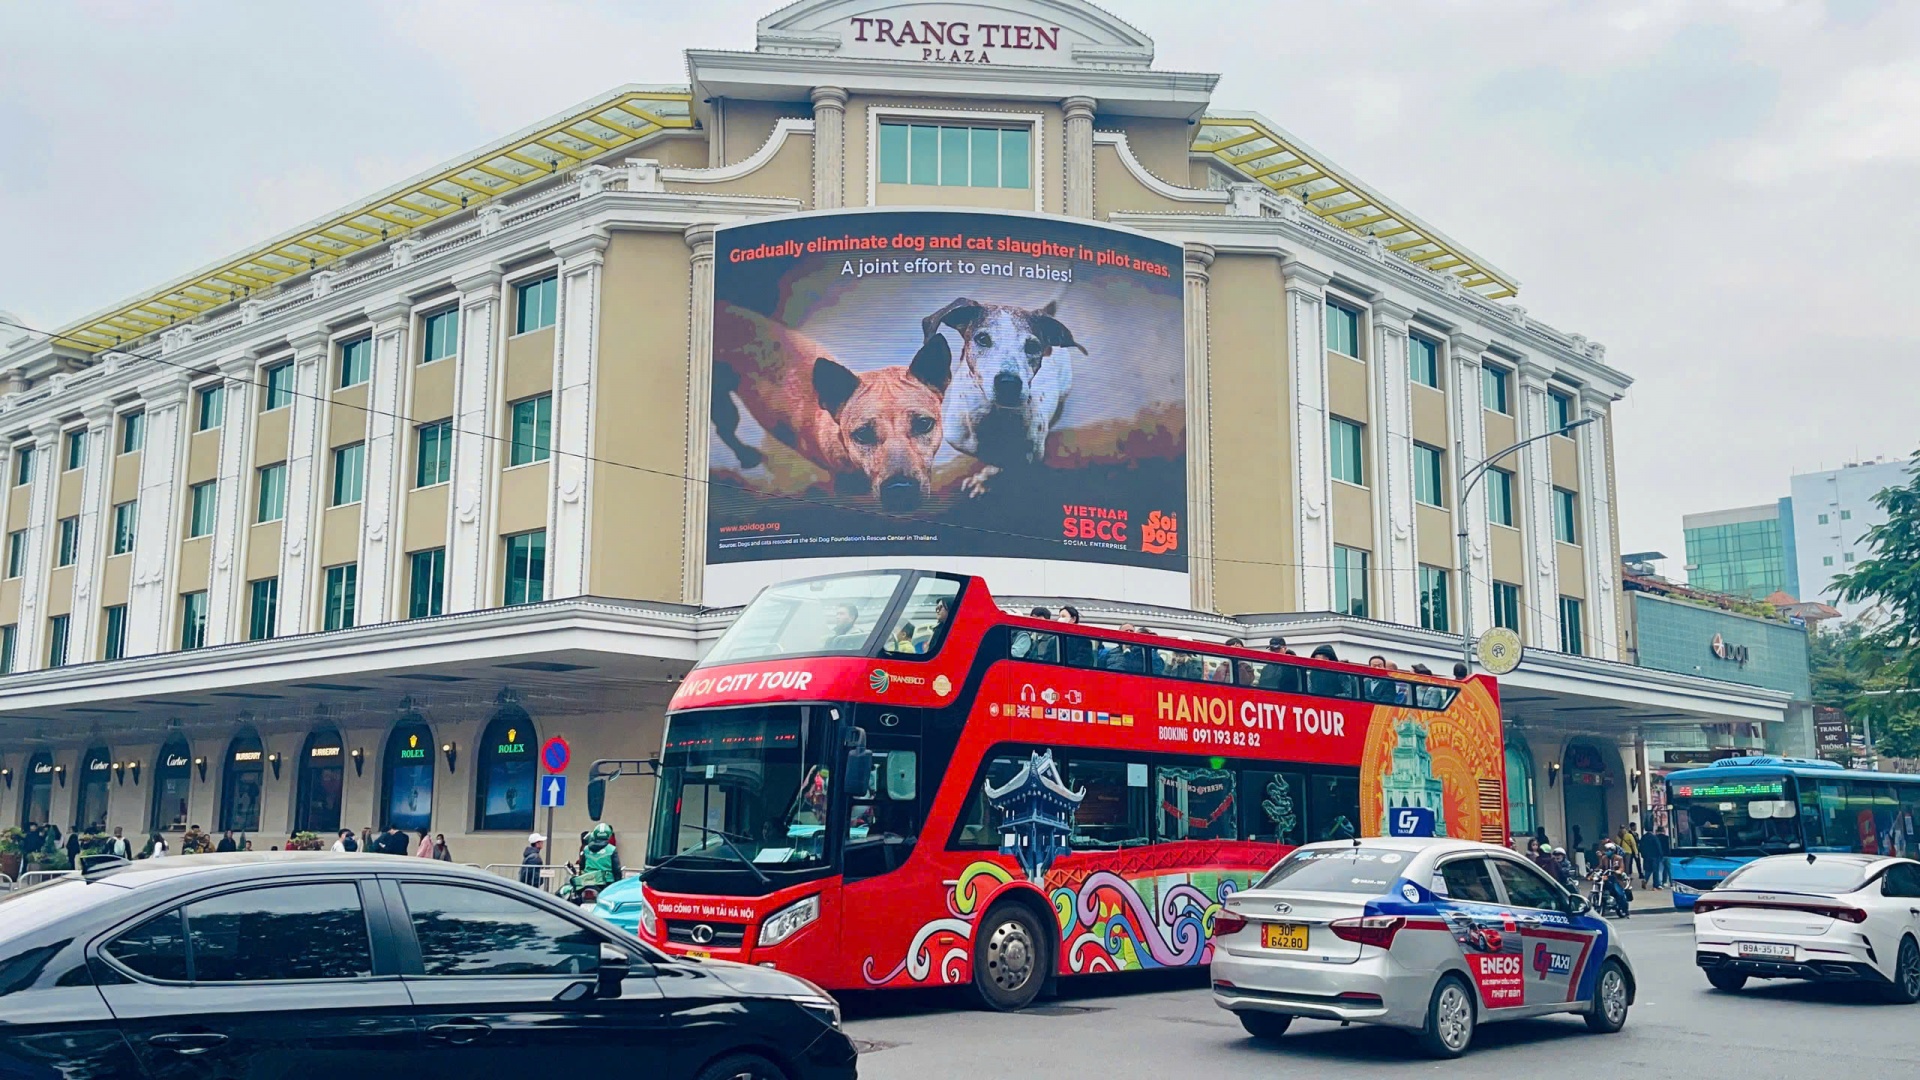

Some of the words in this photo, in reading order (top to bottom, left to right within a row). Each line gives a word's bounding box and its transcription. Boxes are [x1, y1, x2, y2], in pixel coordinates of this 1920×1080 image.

[850, 17, 970, 47] TRANG
[977, 23, 1060, 50] TIEN
[922, 48, 991, 63] PLAZA
[729, 239, 804, 263] Gradually
[806, 234, 888, 253] eliminate
[891, 233, 925, 251] dog
[928, 233, 962, 249] and
[966, 236, 993, 250] cat
[997, 237, 1076, 258] slaughter
[1079, 244, 1093, 262] in
[1096, 249, 1131, 268] pilot
[1132, 257, 1171, 278] areas.
[841, 260, 854, 275] A
[857, 258, 899, 278] joint
[903, 257, 953, 274] effort
[957, 260, 976, 274] to
[980, 261, 1013, 276] end
[1019, 263, 1073, 283] rabies!
[1063, 504, 1128, 520] VIETNAM
[719, 522, 781, 533] www.soidog.org
[1149, 510, 1177, 532] Soi
[1063, 518, 1127, 542] SBCC
[1089, 541, 1128, 550] ENTERPRISE
[1142, 525, 1178, 552] Dog
[676, 677, 717, 698] ANOI
[716, 672, 759, 693] CITY
[758, 671, 813, 691] TOUR
[890, 675, 925, 685] TRANSERCO
[1157, 691, 1234, 726] HANOI
[1240, 700, 1287, 731] CITY
[1293, 707, 1345, 737] TOUR
[1158, 726, 1188, 742] BOOKING
[1193, 728, 1211, 744] 091
[1213, 729, 1231, 745] 193
[1232, 731, 1246, 746] 82
[1247, 732, 1261, 747] 82
[401, 749, 425, 759] ROLEX
[498, 743, 524, 754] ROLEX
[90, 758, 109, 770] Cartier
[166, 754, 188, 767] Cartier
[1398, 810, 1420, 834] G7
[674, 902, 692, 914] CÔNG
[692, 905, 701, 914] TY
[716, 903, 727, 916] TẢI
[728, 905, 738, 917] HÀ
[1278, 925, 1297, 936] 30F
[1271, 937, 1303, 948] 642.80
[1743, 944, 1790, 955] 89A-351.75
[1480, 956, 1520, 975] ENEOS
[1551, 954, 1571, 970] TAXI
